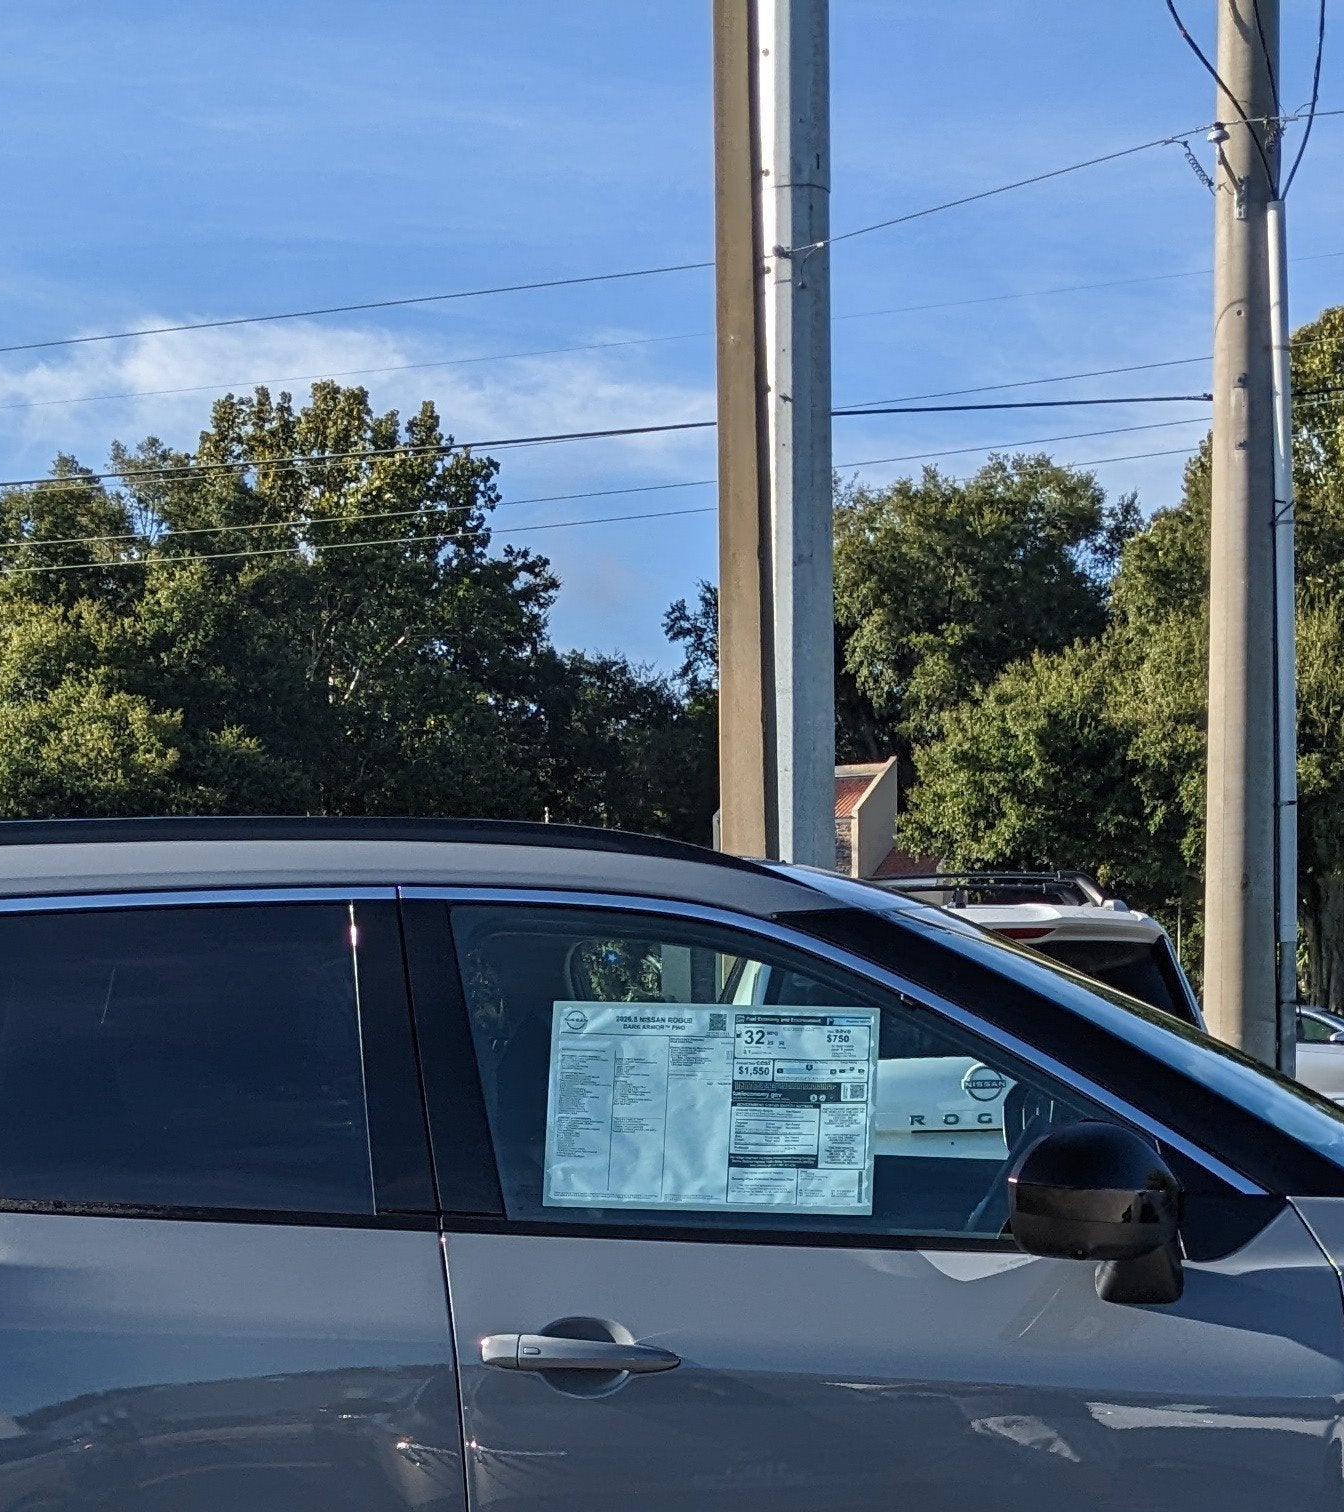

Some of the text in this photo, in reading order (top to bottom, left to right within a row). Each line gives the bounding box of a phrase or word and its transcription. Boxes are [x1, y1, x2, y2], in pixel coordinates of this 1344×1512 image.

[744, 1029, 765, 1045] 32
[826, 1034, 850, 1043] $750
[738, 1065, 770, 1076] $1,550
[964, 1080, 1006, 1088] NISSAN
[909, 1112, 1003, 1126] ROG
